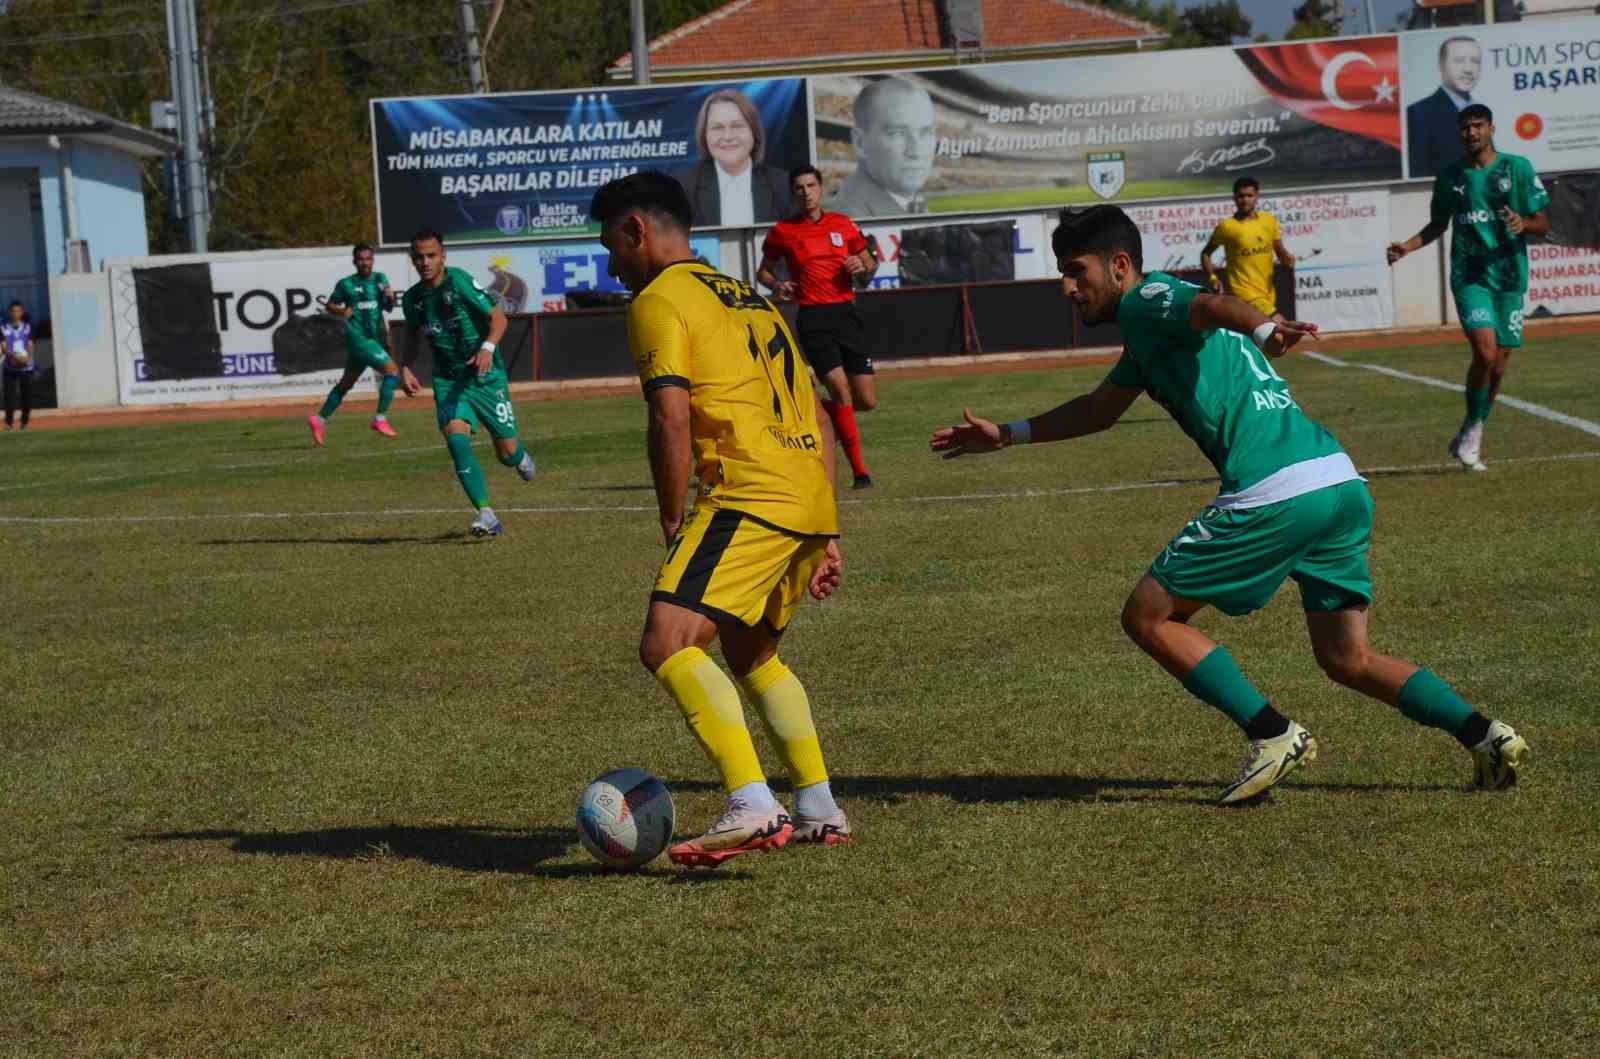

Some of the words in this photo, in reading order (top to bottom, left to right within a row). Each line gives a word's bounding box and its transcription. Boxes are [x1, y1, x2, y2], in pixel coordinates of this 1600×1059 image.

[1489, 43, 1546, 69] TÜM
[1028, 99, 1135, 124] Sporcunun
[409, 124, 574, 150] MÜSABAKALARA
[578, 119, 663, 142] KATILAN
[985, 126, 1080, 152] Zamanda
[387, 152, 421, 170] TÜM
[486, 148, 546, 167] SPORCU
[549, 148, 568, 163] VE
[570, 141, 689, 161] ANTRENÖRLERE
[440, 171, 552, 198] BAŞARILAR
[539, 202, 578, 216] Hatice
